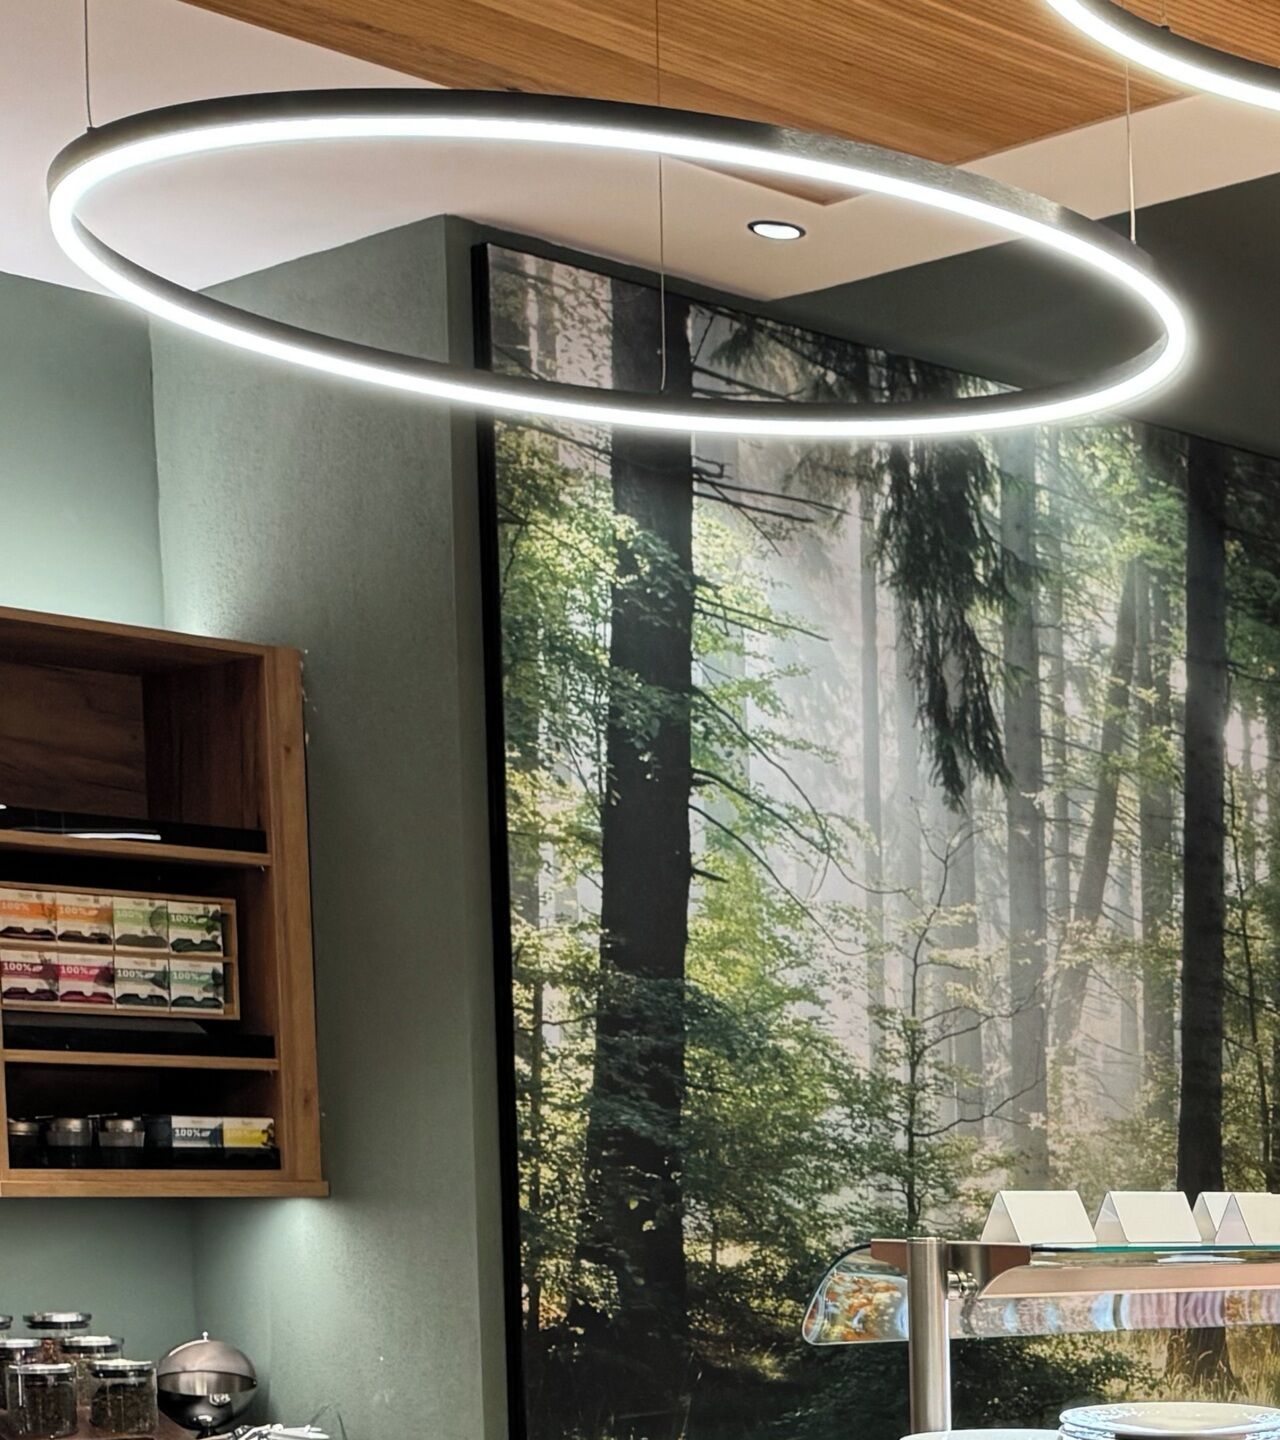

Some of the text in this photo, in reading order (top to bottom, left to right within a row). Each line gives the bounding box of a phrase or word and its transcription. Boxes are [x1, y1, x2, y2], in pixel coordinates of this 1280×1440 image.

[2, 901, 30, 911] 100%
[171, 914, 196, 924] 100%
[3, 962, 31, 972] 100%
[61, 965, 89, 975] 100%
[116, 969, 143, 979] 100%
[172, 971, 198, 981] 100%
[174, 1128, 201, 1137] 100%
